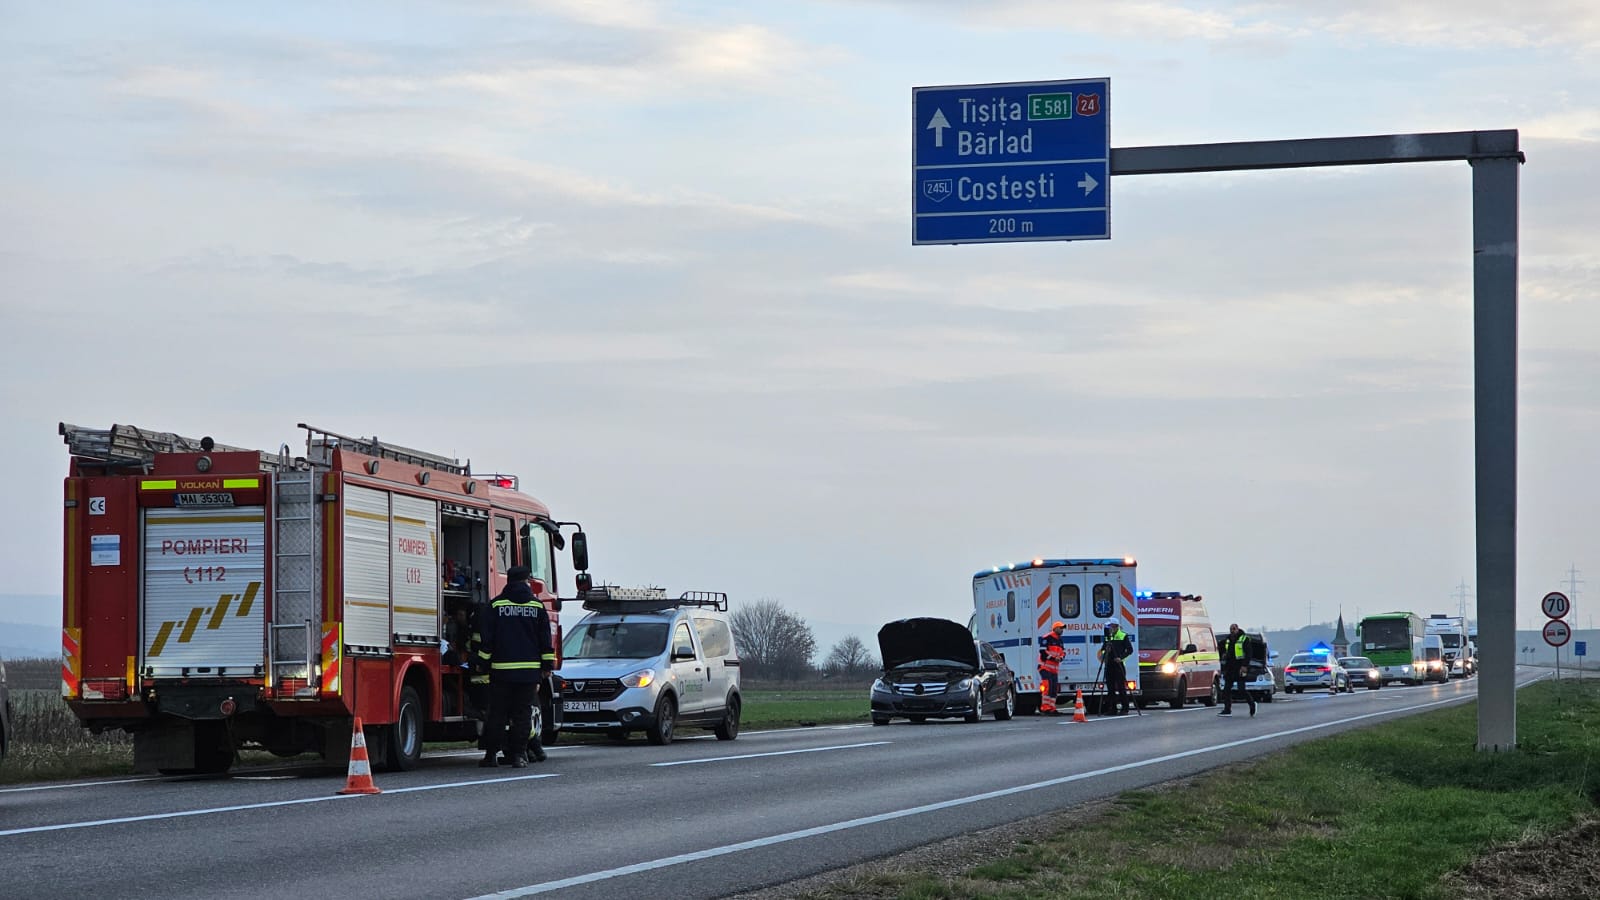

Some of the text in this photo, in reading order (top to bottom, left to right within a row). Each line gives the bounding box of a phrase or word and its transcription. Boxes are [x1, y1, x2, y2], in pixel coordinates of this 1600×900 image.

[958, 97, 1022, 126] Tișița
[1033, 98, 1067, 116] E 581
[1081, 99, 1095, 112] 24
[958, 127, 1033, 156] Bârlad
[927, 182, 950, 194] 245L
[958, 172, 1055, 203] Costești
[989, 218, 1034, 233] 200 m
[180, 480, 220, 489] VOLKAN
[90, 500, 104, 512] CE
[180, 494, 232, 504] MAI 35302
[162, 538, 248, 555] POMPIERI
[399, 537, 428, 556] POMPIERI
[194, 566, 226, 582] 112
[410, 568, 421, 584] 112
[499, 606, 538, 618] POMPIERII
[1548, 598, 1565, 612] 70
[1066, 623, 1103, 631] MBULAN
[571, 702, 580, 710] 22
